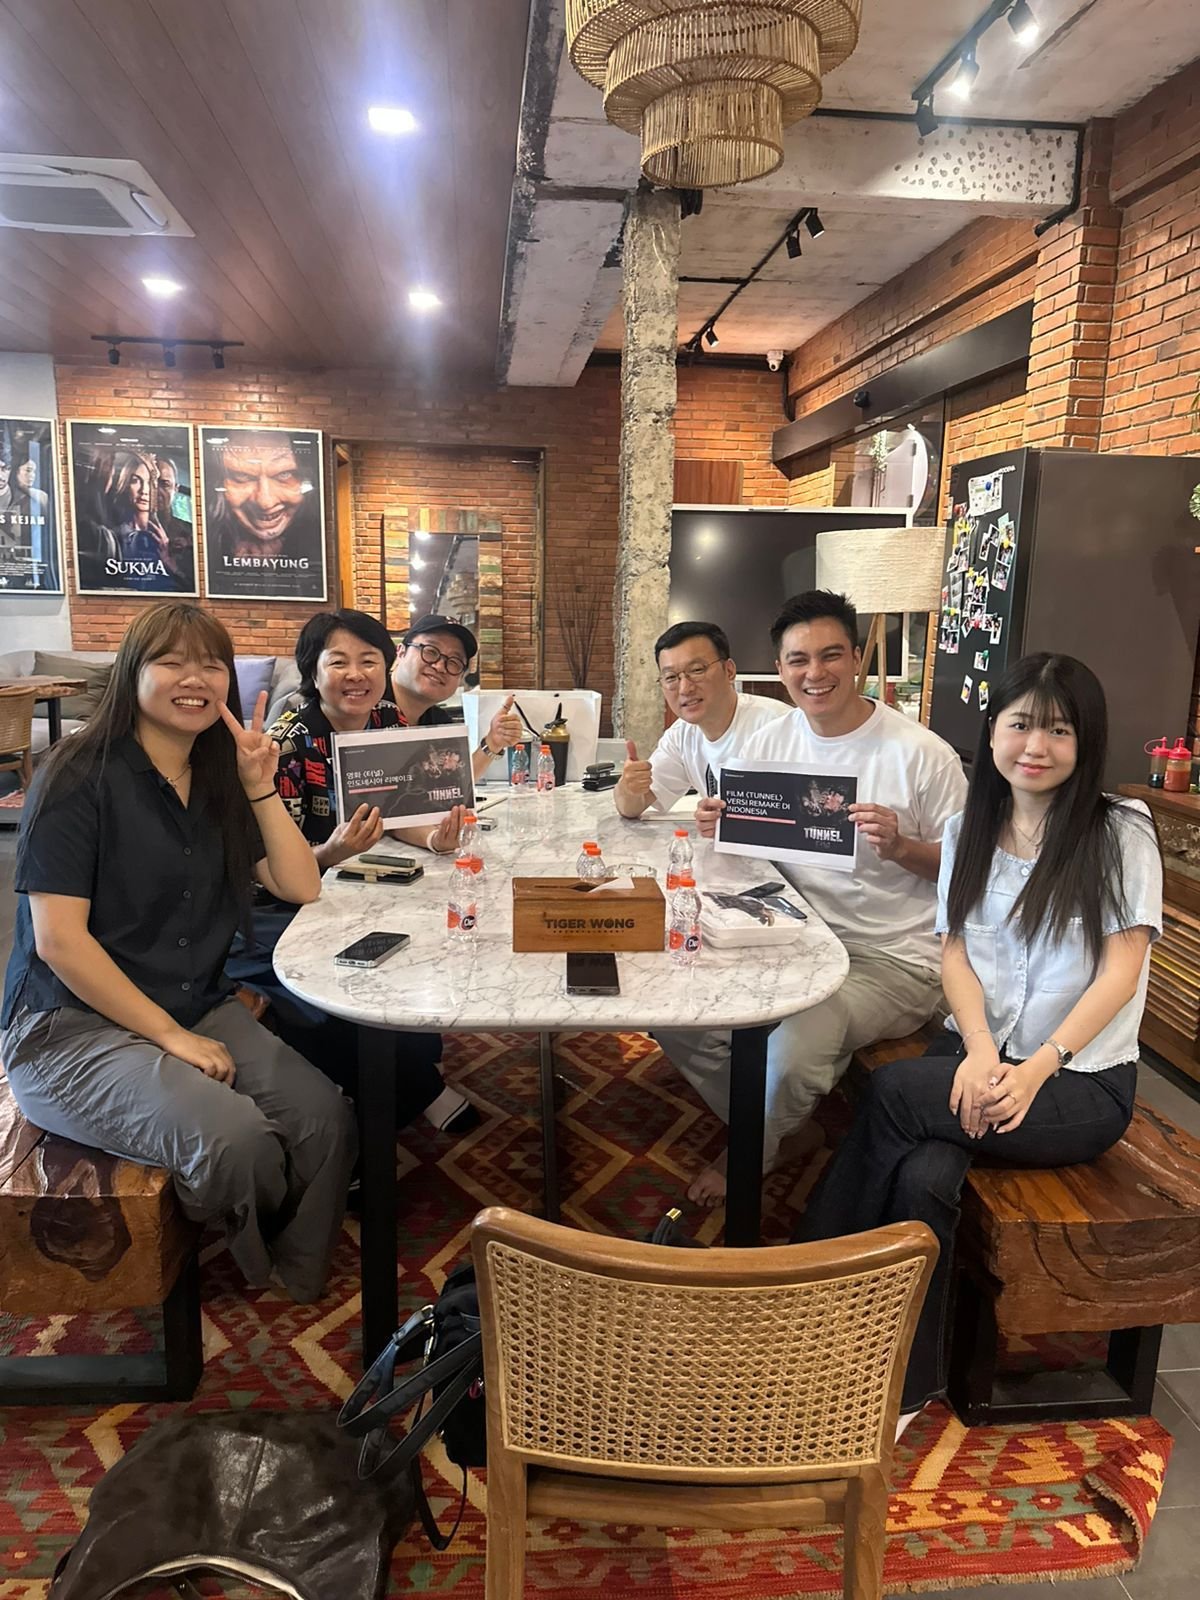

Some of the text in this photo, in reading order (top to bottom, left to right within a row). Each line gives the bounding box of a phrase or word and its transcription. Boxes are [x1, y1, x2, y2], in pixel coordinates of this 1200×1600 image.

[11, 515, 45, 525] KEJAM
[105, 559, 169, 576] SUKMA
[223, 556, 309, 570] LEMBAYUNG
[346, 772, 361, 780] 영화
[347, 775, 413, 787] 인도네시아 리메이크
[427, 788, 464, 801] TUNNEL
[726, 805, 768, 815] INDONESIA
[749, 800, 780, 809] REMAKE
[803, 827, 844, 842] TUNNEL
[544, 918, 635, 929] TIGER WONG
